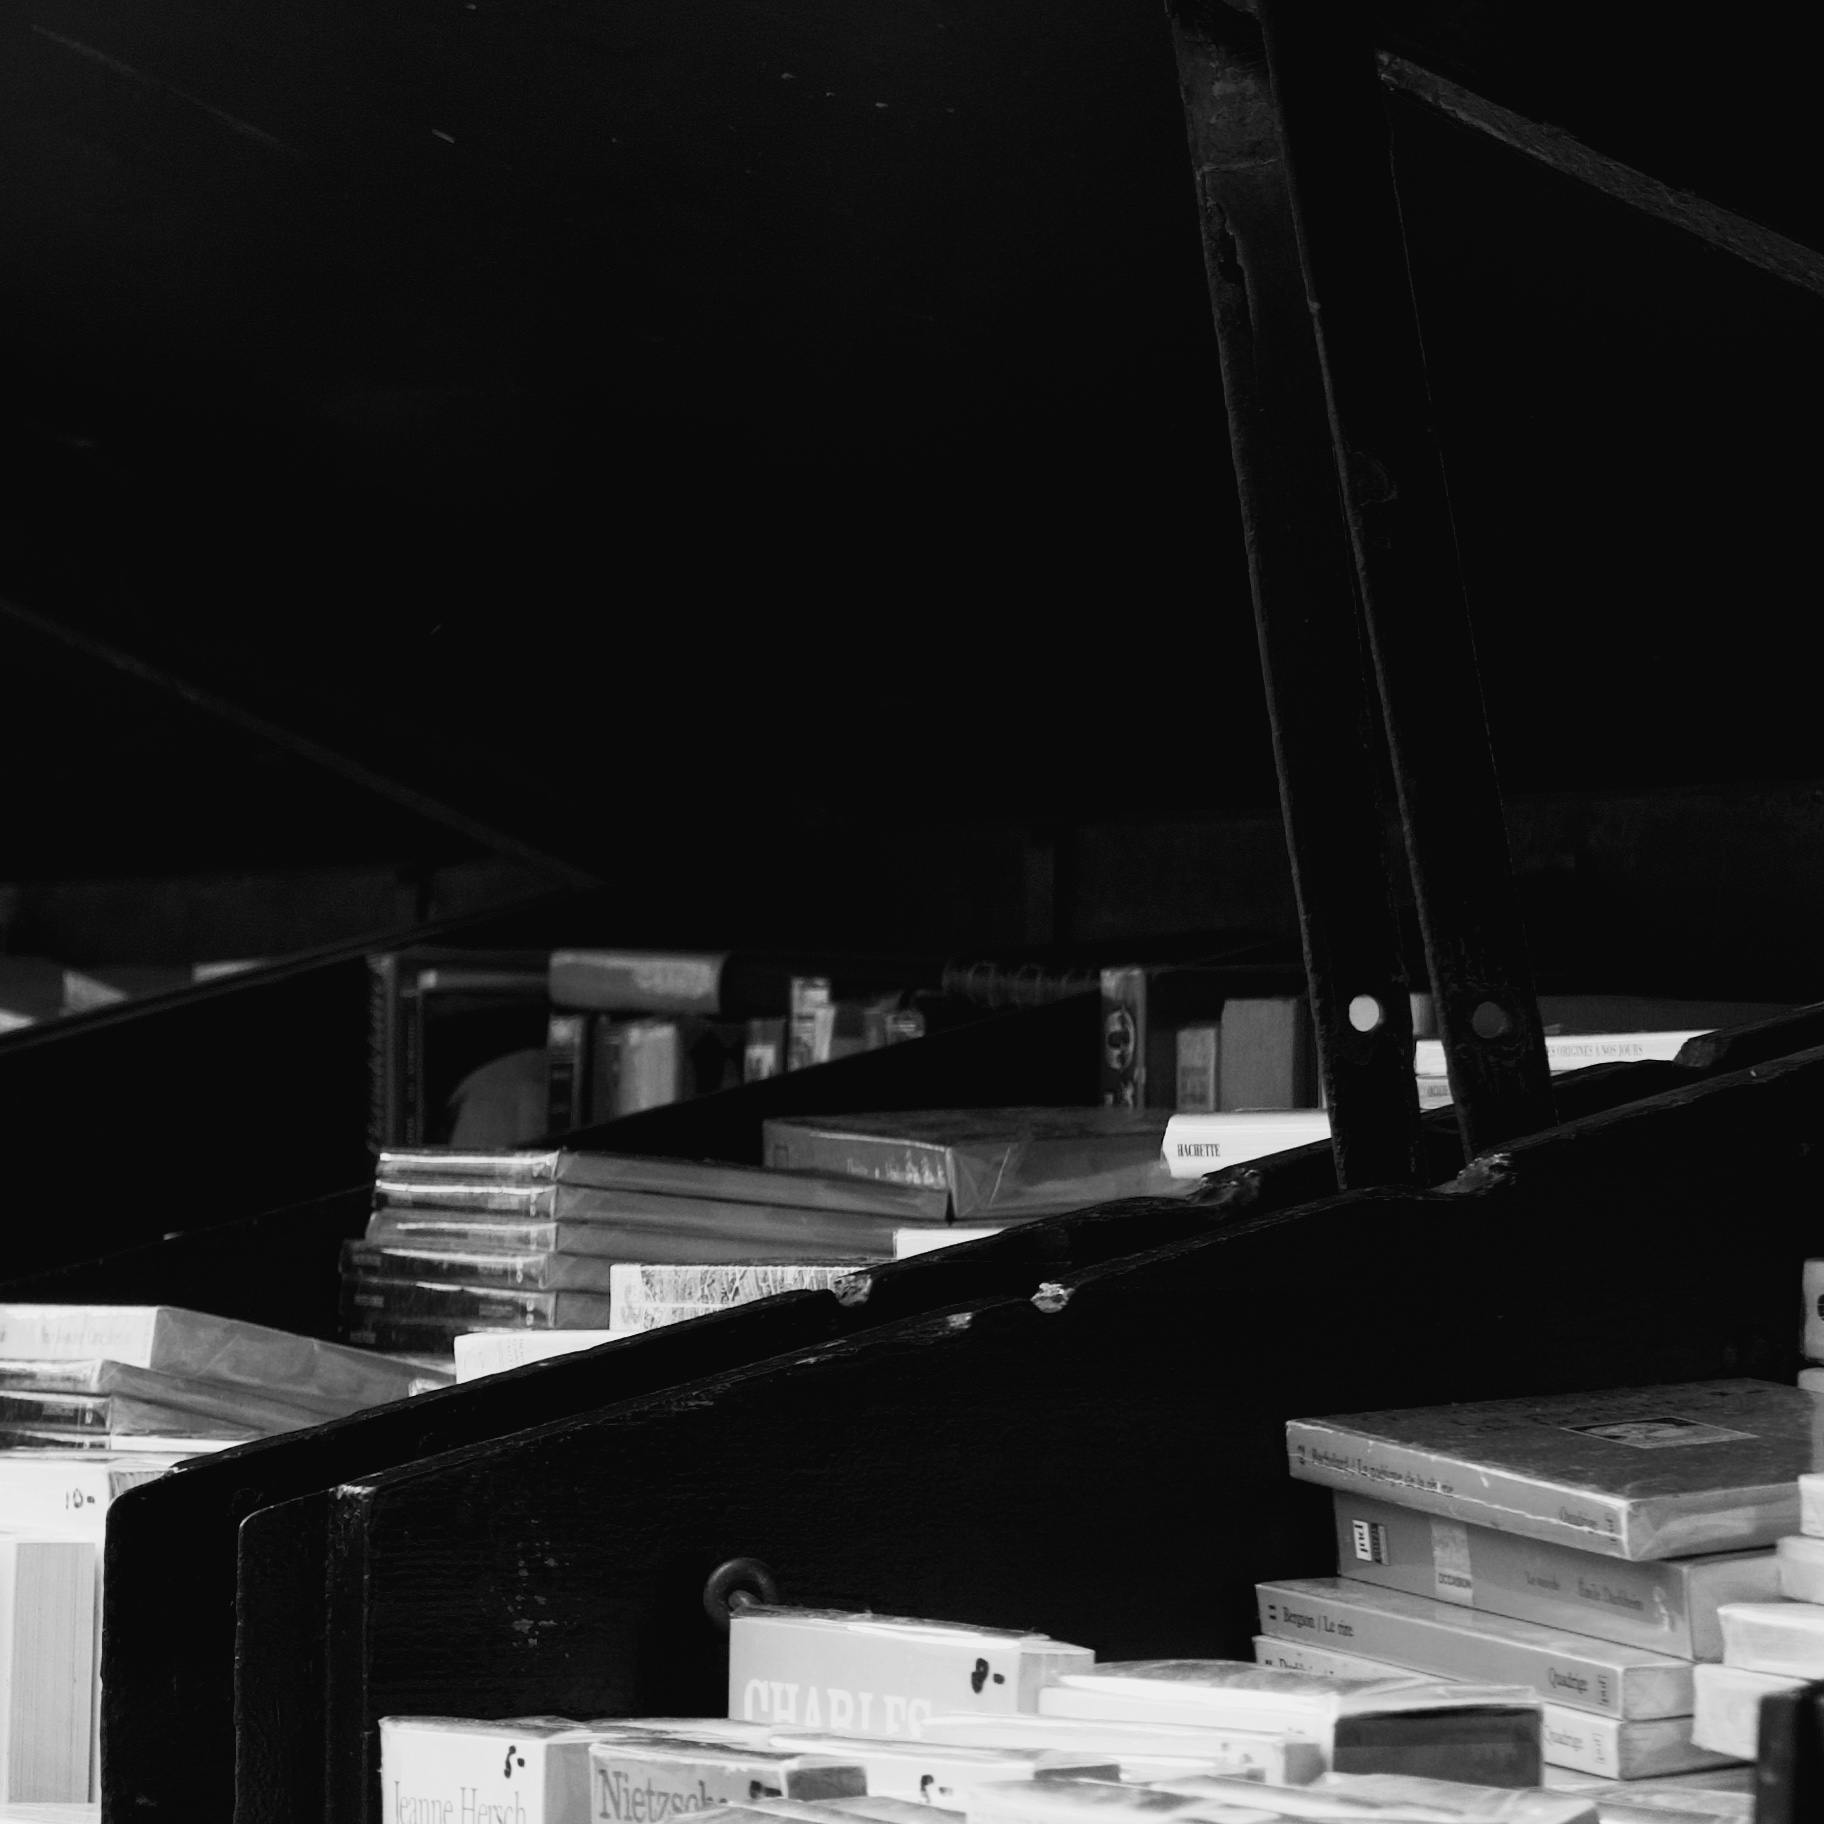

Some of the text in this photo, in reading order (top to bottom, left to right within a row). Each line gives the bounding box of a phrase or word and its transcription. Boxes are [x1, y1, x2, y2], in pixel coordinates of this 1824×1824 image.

[1177, 1143, 1221, 1158] HACHETTE
[1282, 1605, 1315, 1630] Bergson
[1323, 1614, 1336, 1633] Le
[1548, 1667, 1588, 1695] Quadrige
